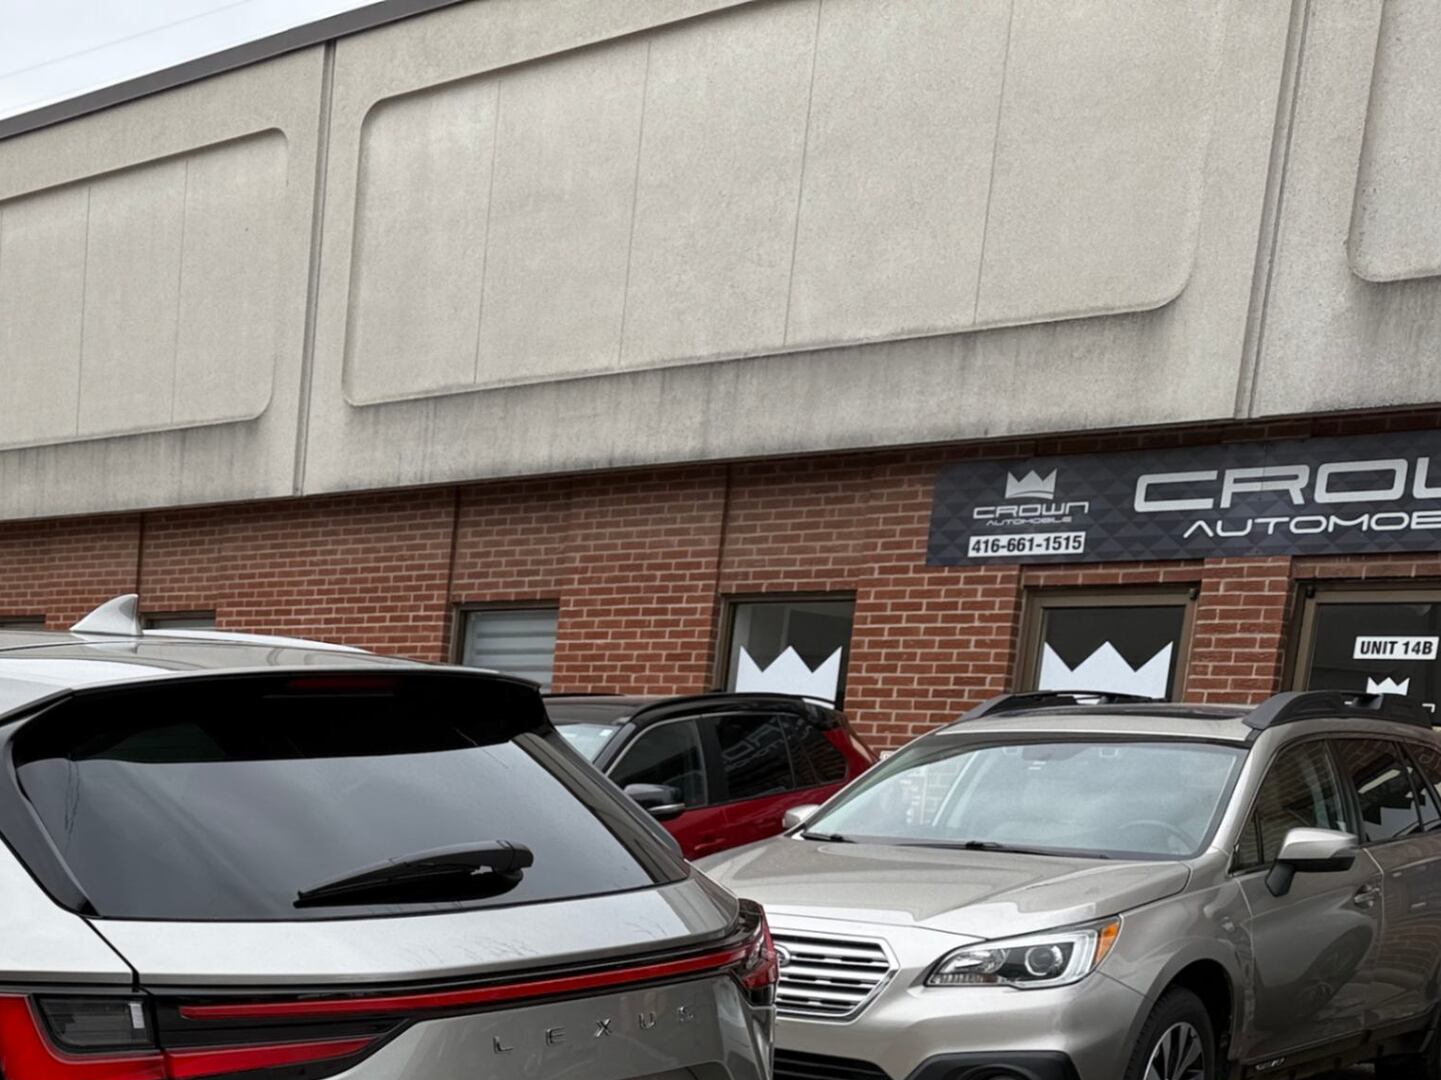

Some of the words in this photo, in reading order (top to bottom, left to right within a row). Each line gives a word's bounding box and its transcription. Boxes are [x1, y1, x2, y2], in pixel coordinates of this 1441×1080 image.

[972, 501, 1089, 519] CROWN
[971, 535, 1082, 554] 416-661-1515
[1360, 640, 1399, 655] UNIT
[1402, 640, 1433, 655] 14B
[492, 1005, 695, 1055] LEXUS
